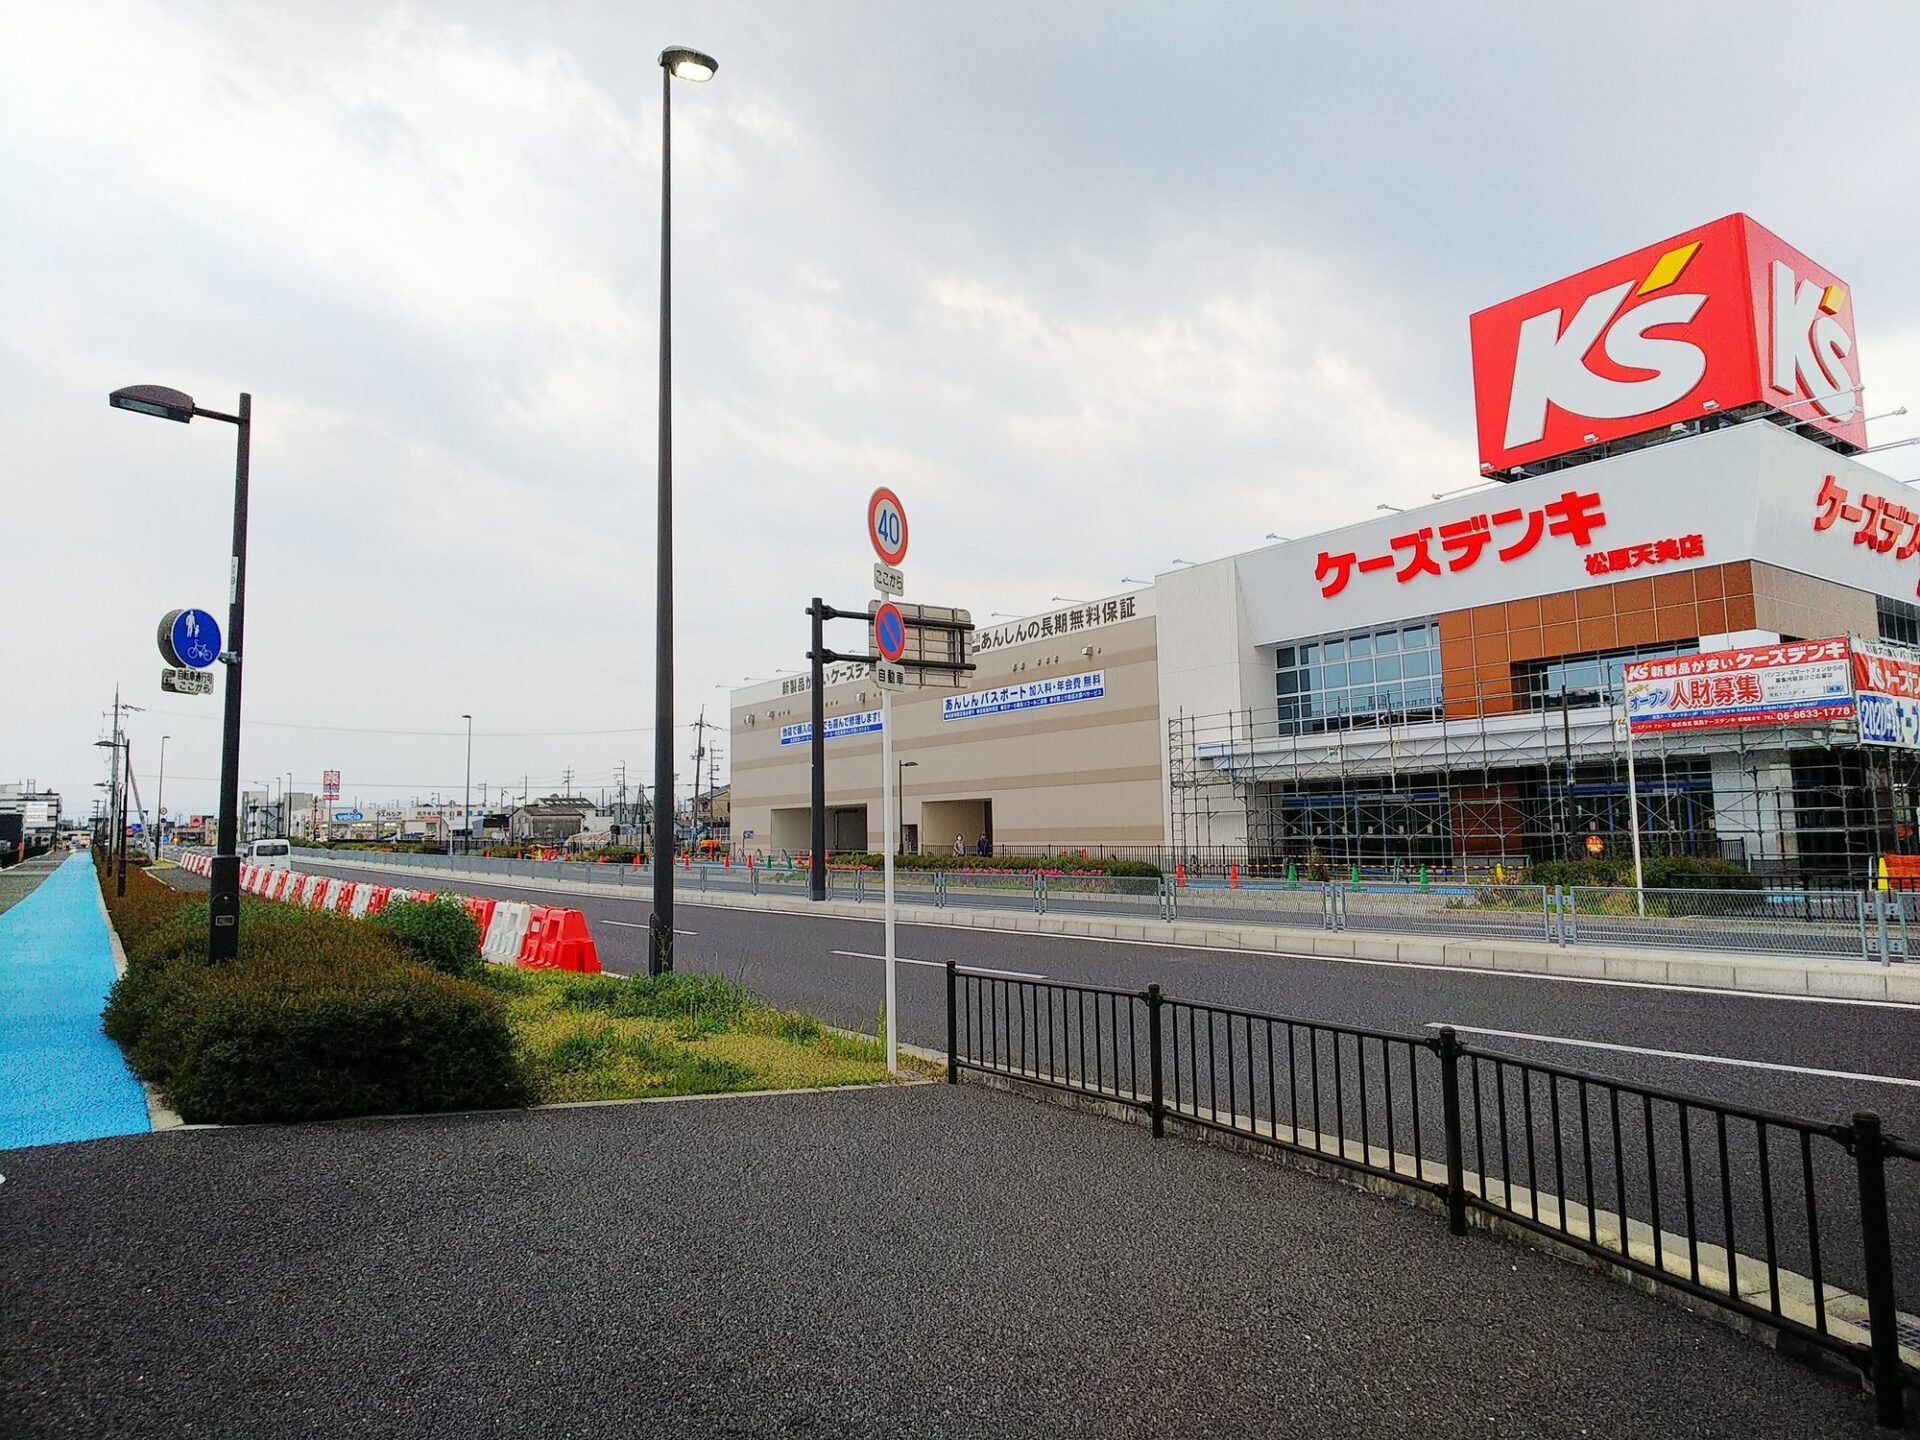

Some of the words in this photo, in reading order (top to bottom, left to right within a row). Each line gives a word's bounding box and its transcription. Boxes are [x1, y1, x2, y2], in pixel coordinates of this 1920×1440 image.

[878, 509, 899, 545] 40
[1314, 491, 1607, 599] ケーズデンキ
[1584, 534, 1705, 576] 松原天美店
[876, 570, 904, 590] ここから
[981, 596, 1137, 650] あんしんの長期無料保証
[180, 681, 211, 694] ここから
[878, 668, 904, 686] 自動車
[945, 686, 1027, 711] あんしんパスポート
[1084, 673, 1101, 688] 無料
[1669, 673, 1763, 710] 人財募集
[1630, 689, 1670, 712] オープン
[1776, 706, 1851, 722] 06-6633-1778
